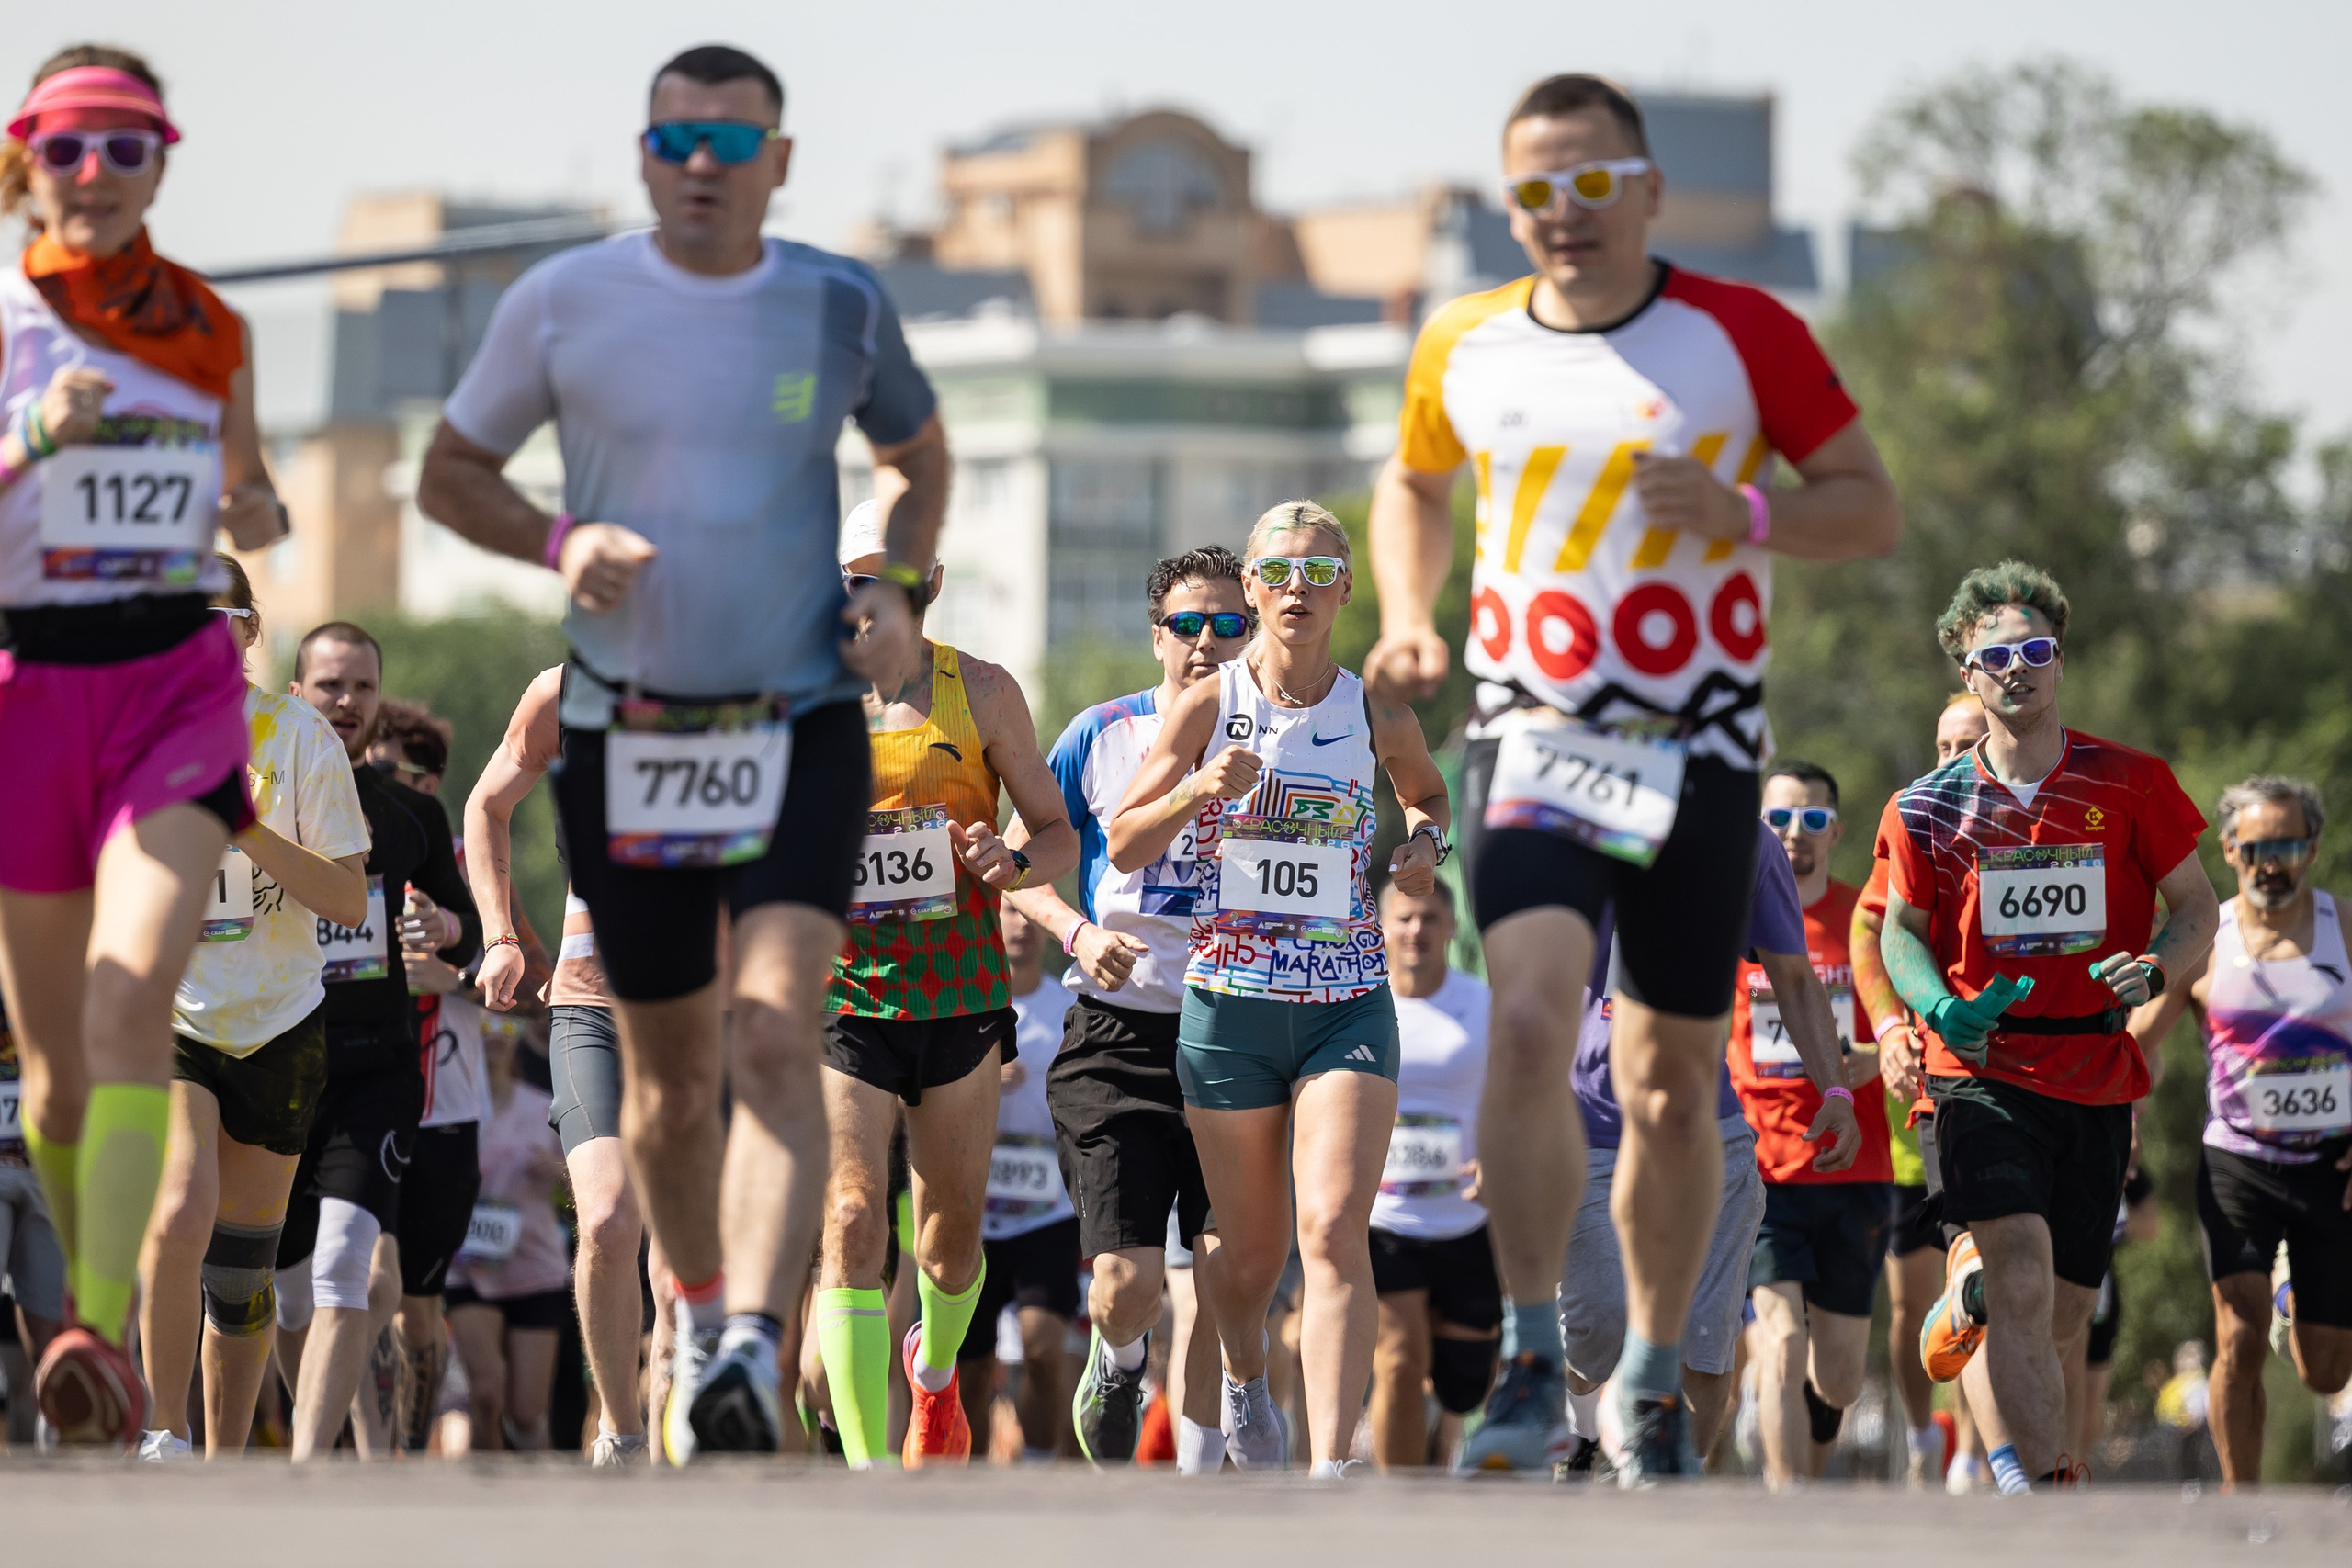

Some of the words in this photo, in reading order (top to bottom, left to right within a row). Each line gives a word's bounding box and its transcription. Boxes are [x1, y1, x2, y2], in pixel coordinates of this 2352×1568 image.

[77, 473, 192, 524] 1127
[1258, 724, 1279, 735] NN
[636, 758, 760, 807] 7760
[1535, 745, 1639, 809] 7761
[866, 807, 936, 827] СОЧНЫЙ
[893, 819, 946, 834] 2026
[1296, 836, 1351, 849] 2026
[1990, 846, 2094, 863] КРАСОЧНЫЙ
[854, 847, 933, 886] 5136
[1256, 858, 1318, 898] 105
[1999, 883, 2086, 919] 6690
[1268, 949, 1389, 987] MARATHON
[2264, 1084, 2336, 1116] 3636
